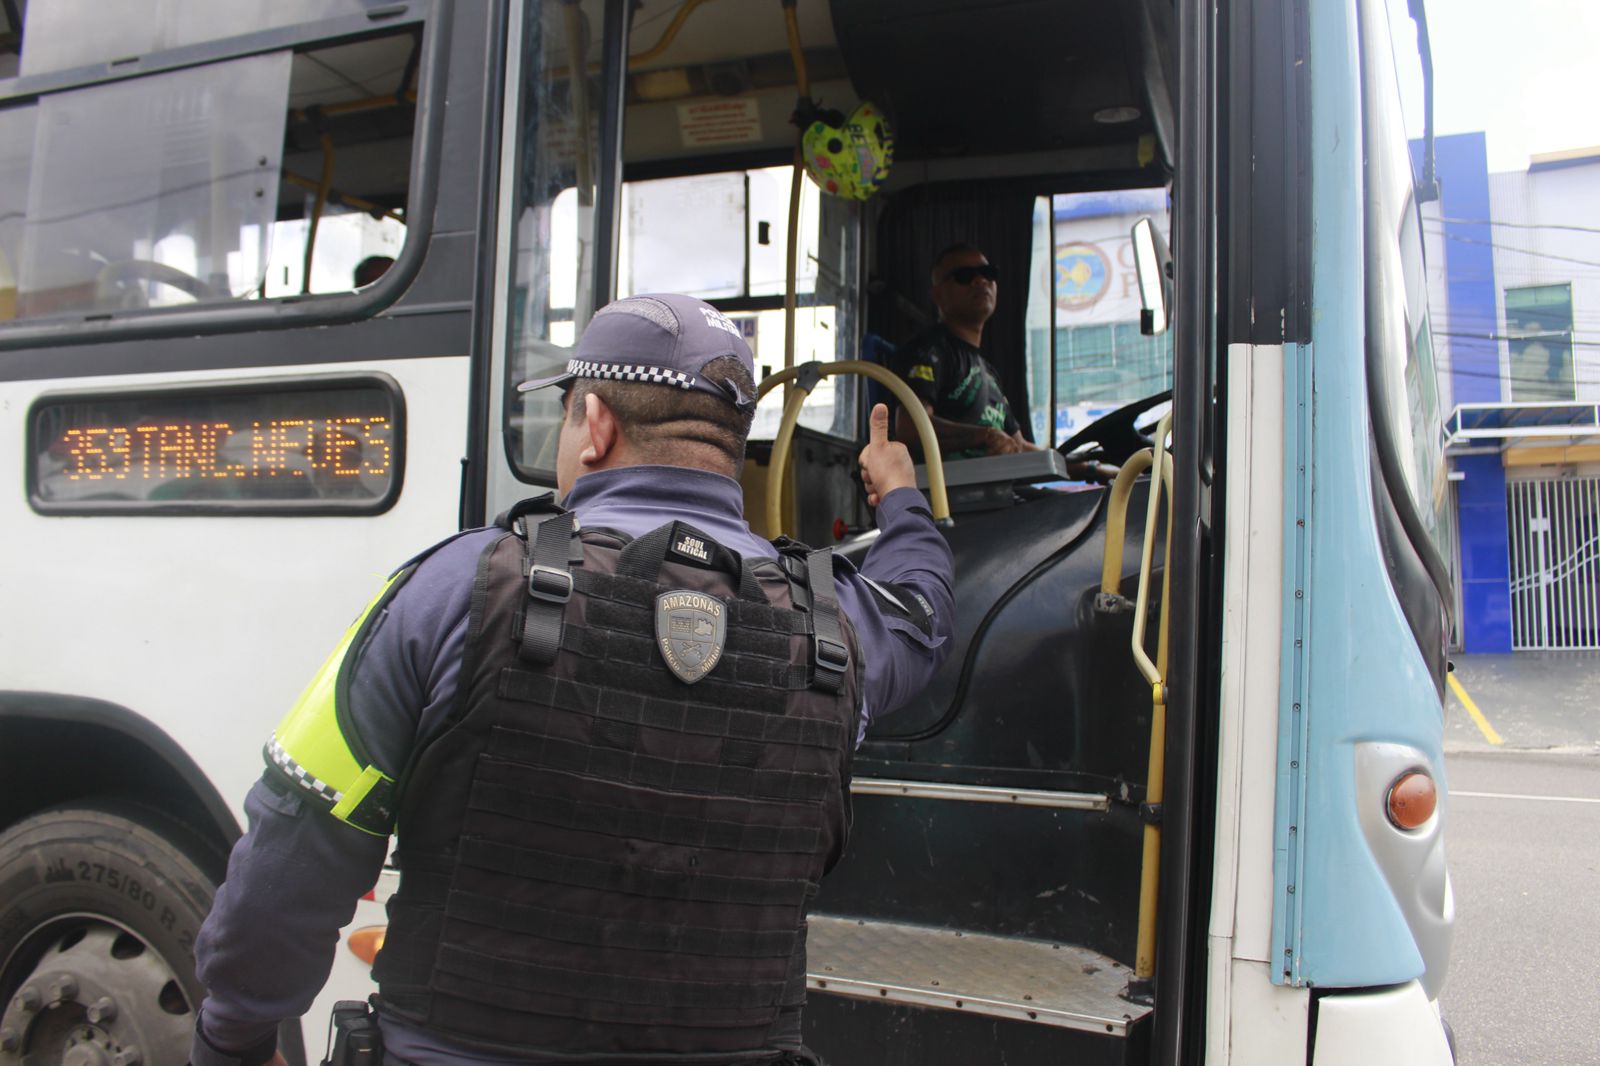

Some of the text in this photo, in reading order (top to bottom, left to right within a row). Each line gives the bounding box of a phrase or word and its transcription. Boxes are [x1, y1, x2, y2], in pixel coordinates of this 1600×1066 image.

[63, 427, 131, 480] 359
[677, 541, 708, 560] TATICAL
[684, 536, 704, 550] SOUL
[663, 596, 721, 617] AMAZONAS
[77, 860, 177, 930] 275/80 R
